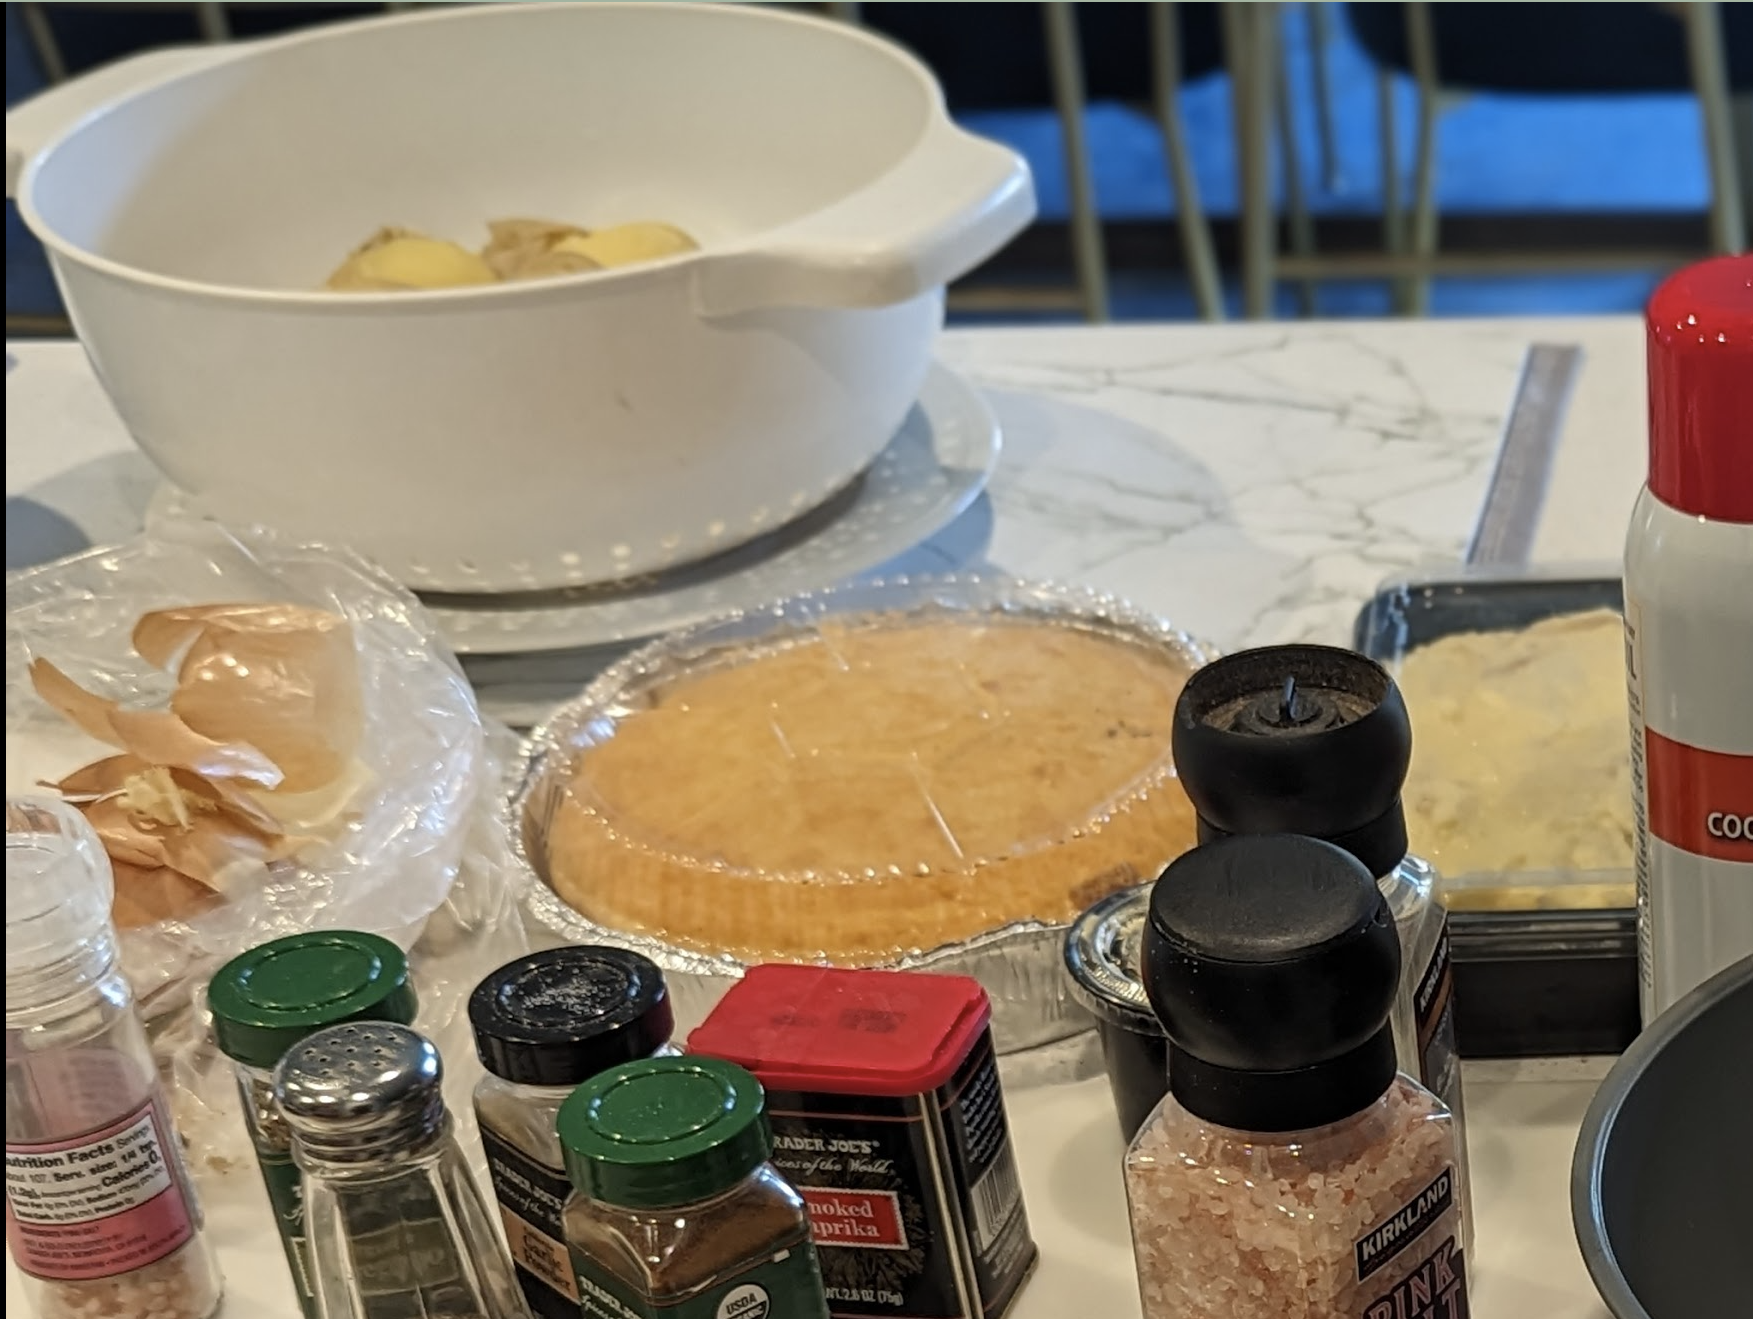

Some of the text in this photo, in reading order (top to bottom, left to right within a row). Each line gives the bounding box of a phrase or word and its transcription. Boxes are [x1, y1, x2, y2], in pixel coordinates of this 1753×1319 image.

[5, 1153, 65, 1169] utrition
[67, 1142, 115, 1164] Facts
[773, 1136, 873, 1155] RADER JOE'S
[773, 1157, 801, 1169] ices
[102, 1161, 150, 1187] Calories
[807, 1198, 874, 1218] moked
[812, 1219, 881, 1238] aprika
[1362, 1175, 1449, 1262] KIRKLAND
